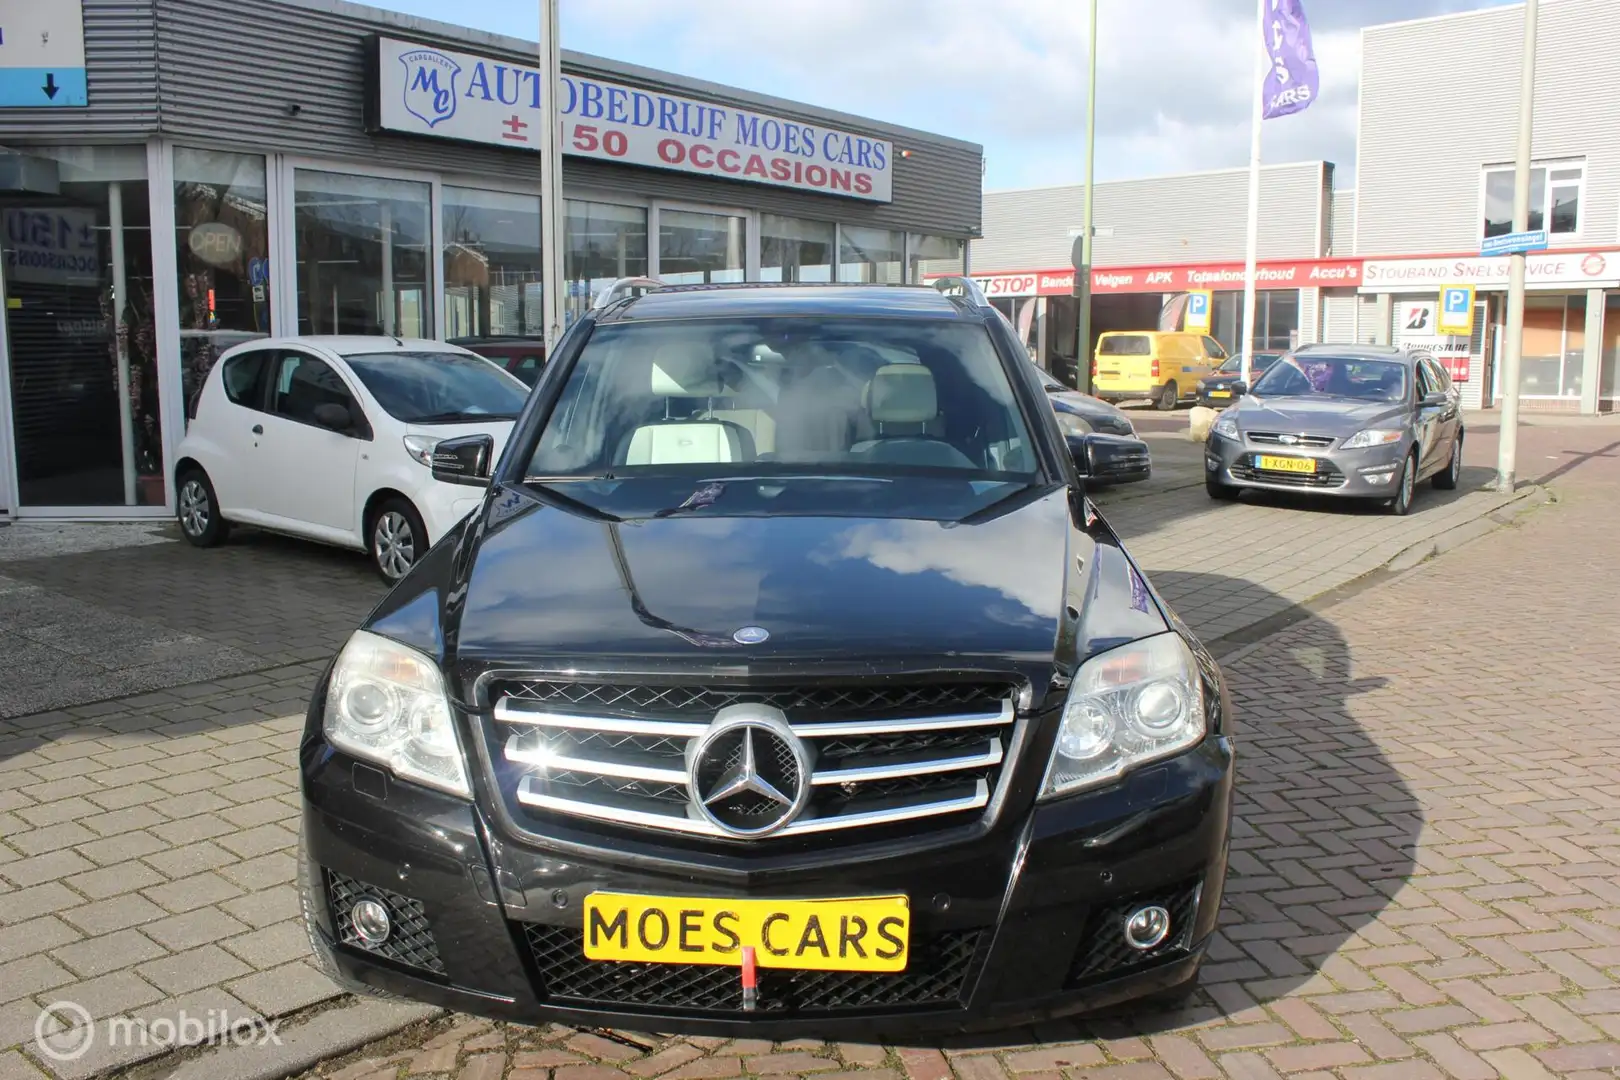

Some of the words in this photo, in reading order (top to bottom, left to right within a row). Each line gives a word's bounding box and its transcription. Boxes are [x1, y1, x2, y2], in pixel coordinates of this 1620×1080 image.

[465, 62, 727, 141] AUTOBEDRIJF
[734, 113, 815, 158] MOES
[823, 132, 886, 171] CARS
[560, 121, 628, 157] 50
[657, 138, 872, 195] OCCASIONS
[189, 231, 243, 255] OPEN
[1095, 273, 1133, 288] Velgen
[1145, 271, 1174, 284] APK
[1187, 267, 1296, 283] Totaalondrhoud
[1310, 265, 1357, 279] Accu's
[1366, 264, 1448, 280] STOUBAND
[589, 906, 741, 954] MOES
[760, 911, 906, 960] CARS
